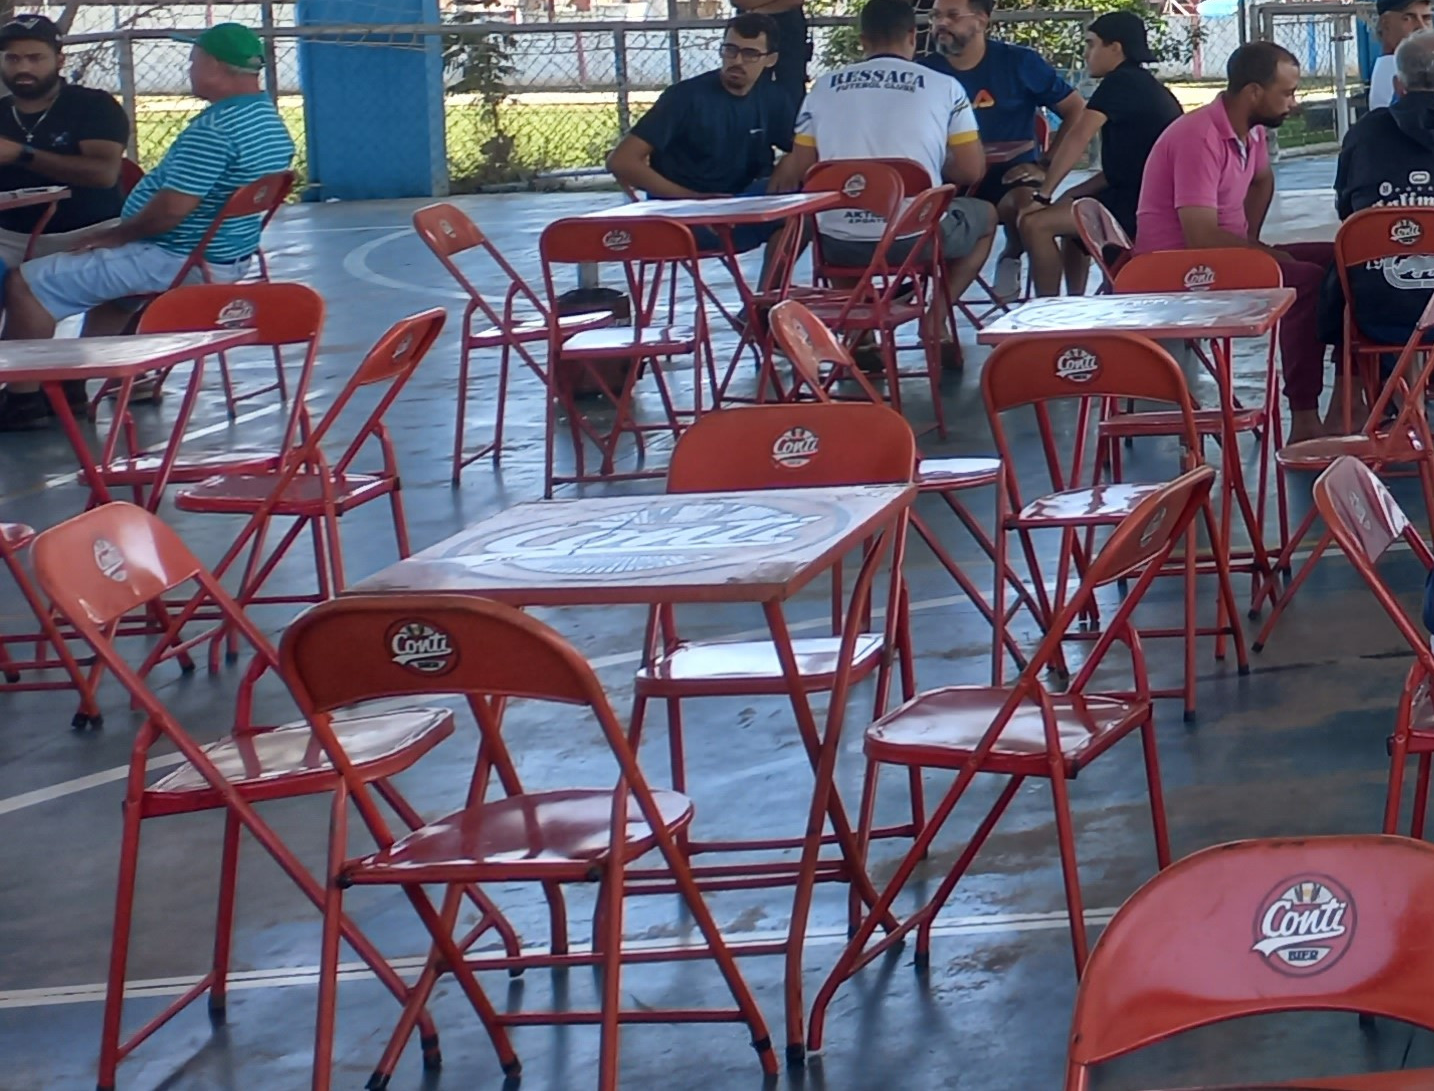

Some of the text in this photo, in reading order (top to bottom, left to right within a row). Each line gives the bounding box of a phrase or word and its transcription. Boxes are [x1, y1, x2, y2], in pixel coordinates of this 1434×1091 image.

[830, 70, 925, 89] RESSACA
[1057, 355, 1097, 371] Conti
[773, 436, 819, 454] Conti
[391, 632, 447, 654] Conti
[1262, 899, 1349, 938] Conti
[1288, 949, 1319, 962] BIER
